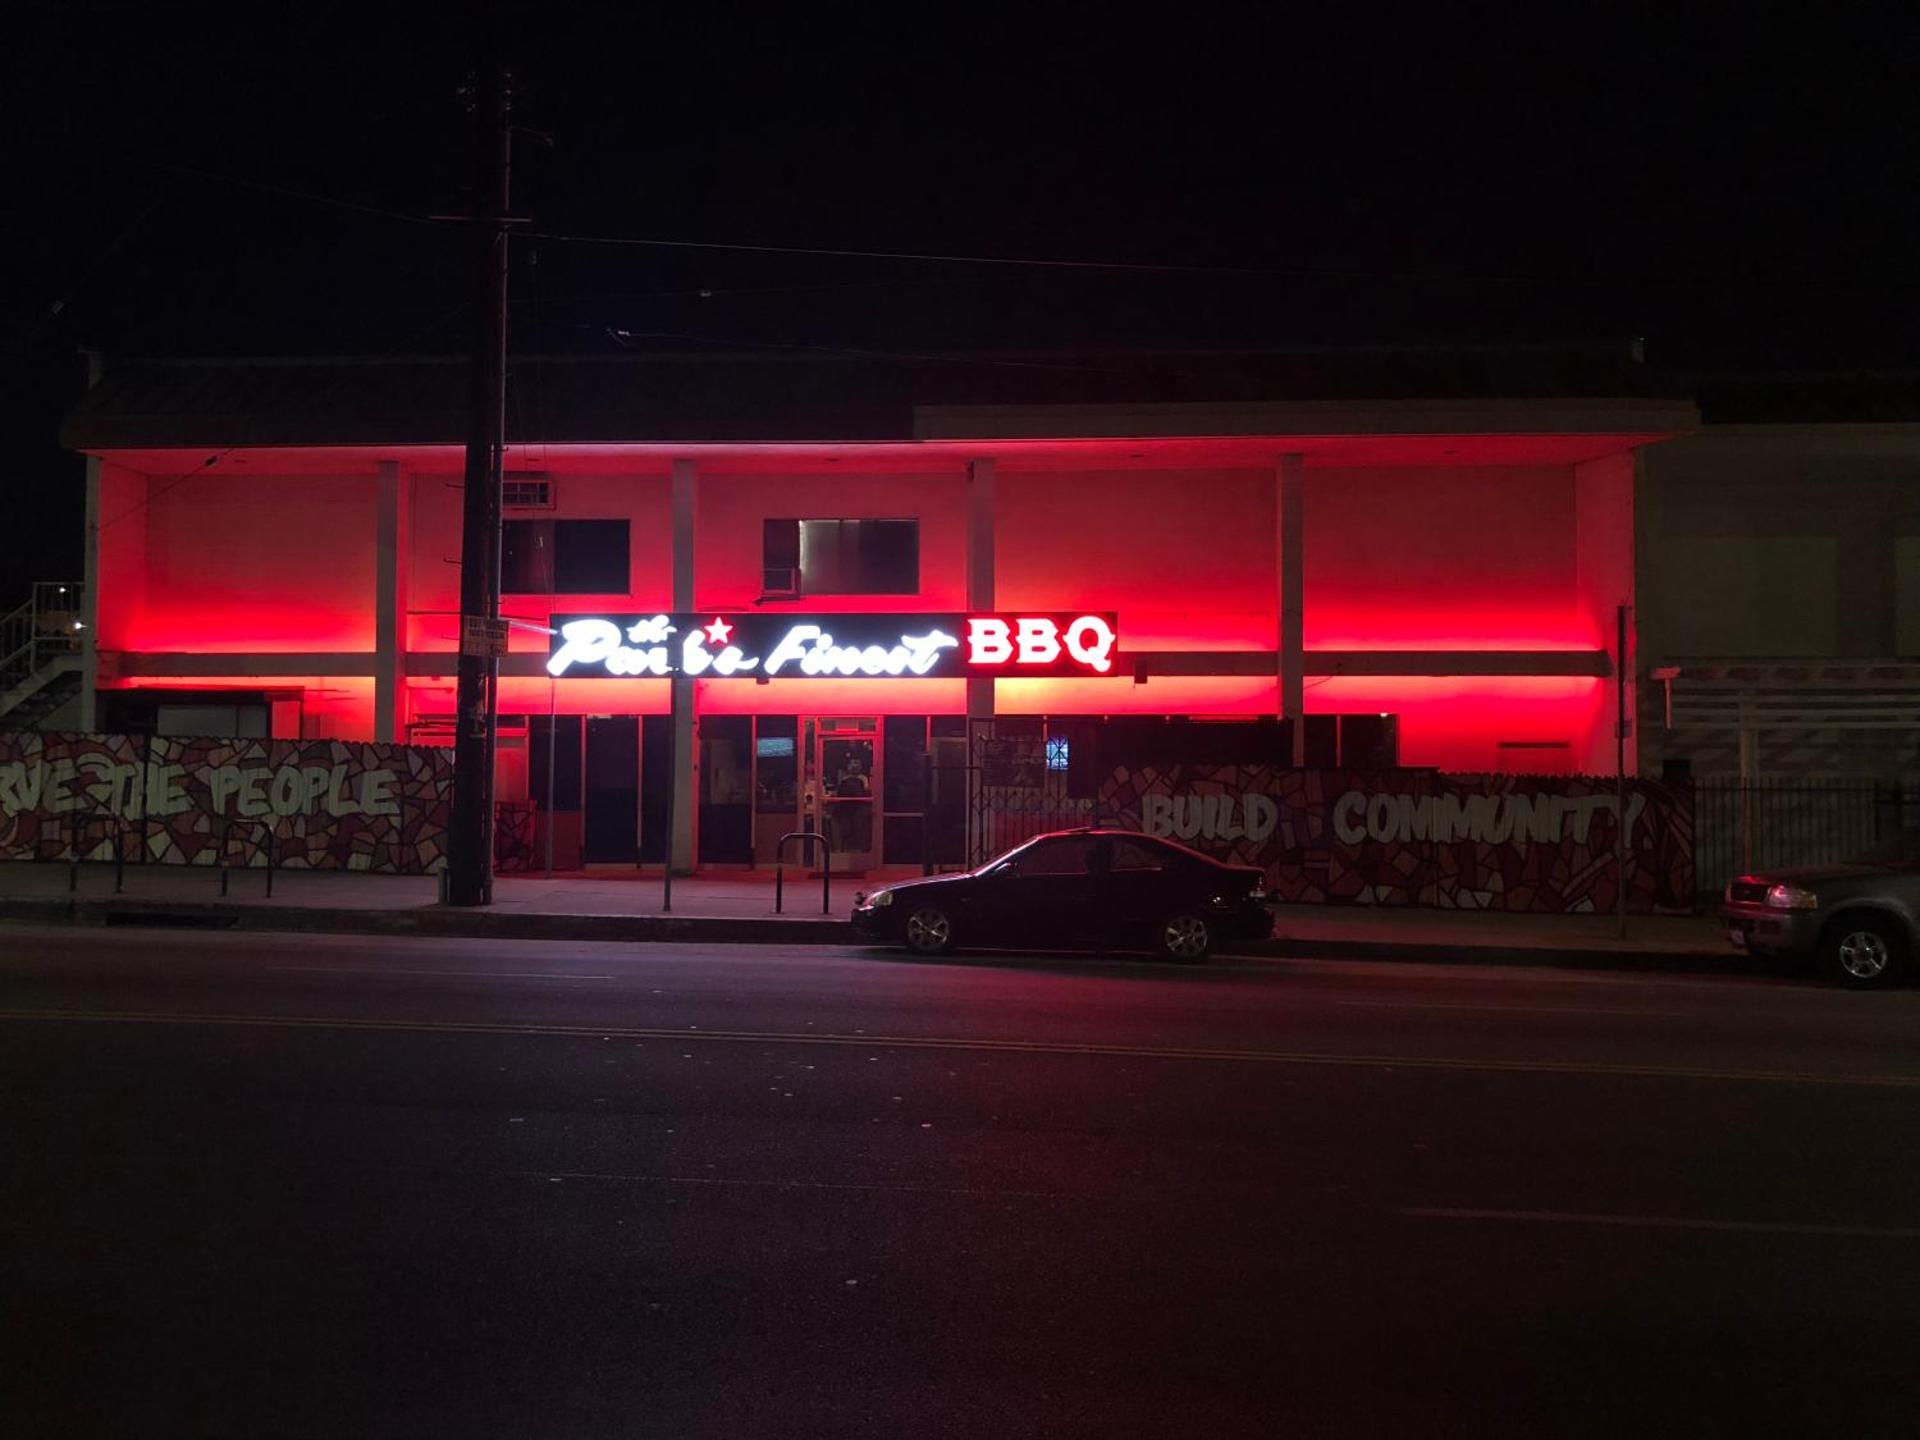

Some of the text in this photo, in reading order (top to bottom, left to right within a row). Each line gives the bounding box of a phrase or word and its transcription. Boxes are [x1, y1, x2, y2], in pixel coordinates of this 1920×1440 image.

[764, 625, 959, 675] Finest
[967, 615, 1116, 672] BBQ
[77, 752, 196, 821] THE
[209, 765, 401, 817] PEOPLE
[1141, 791, 1648, 848] BUILD COMMUNITY
